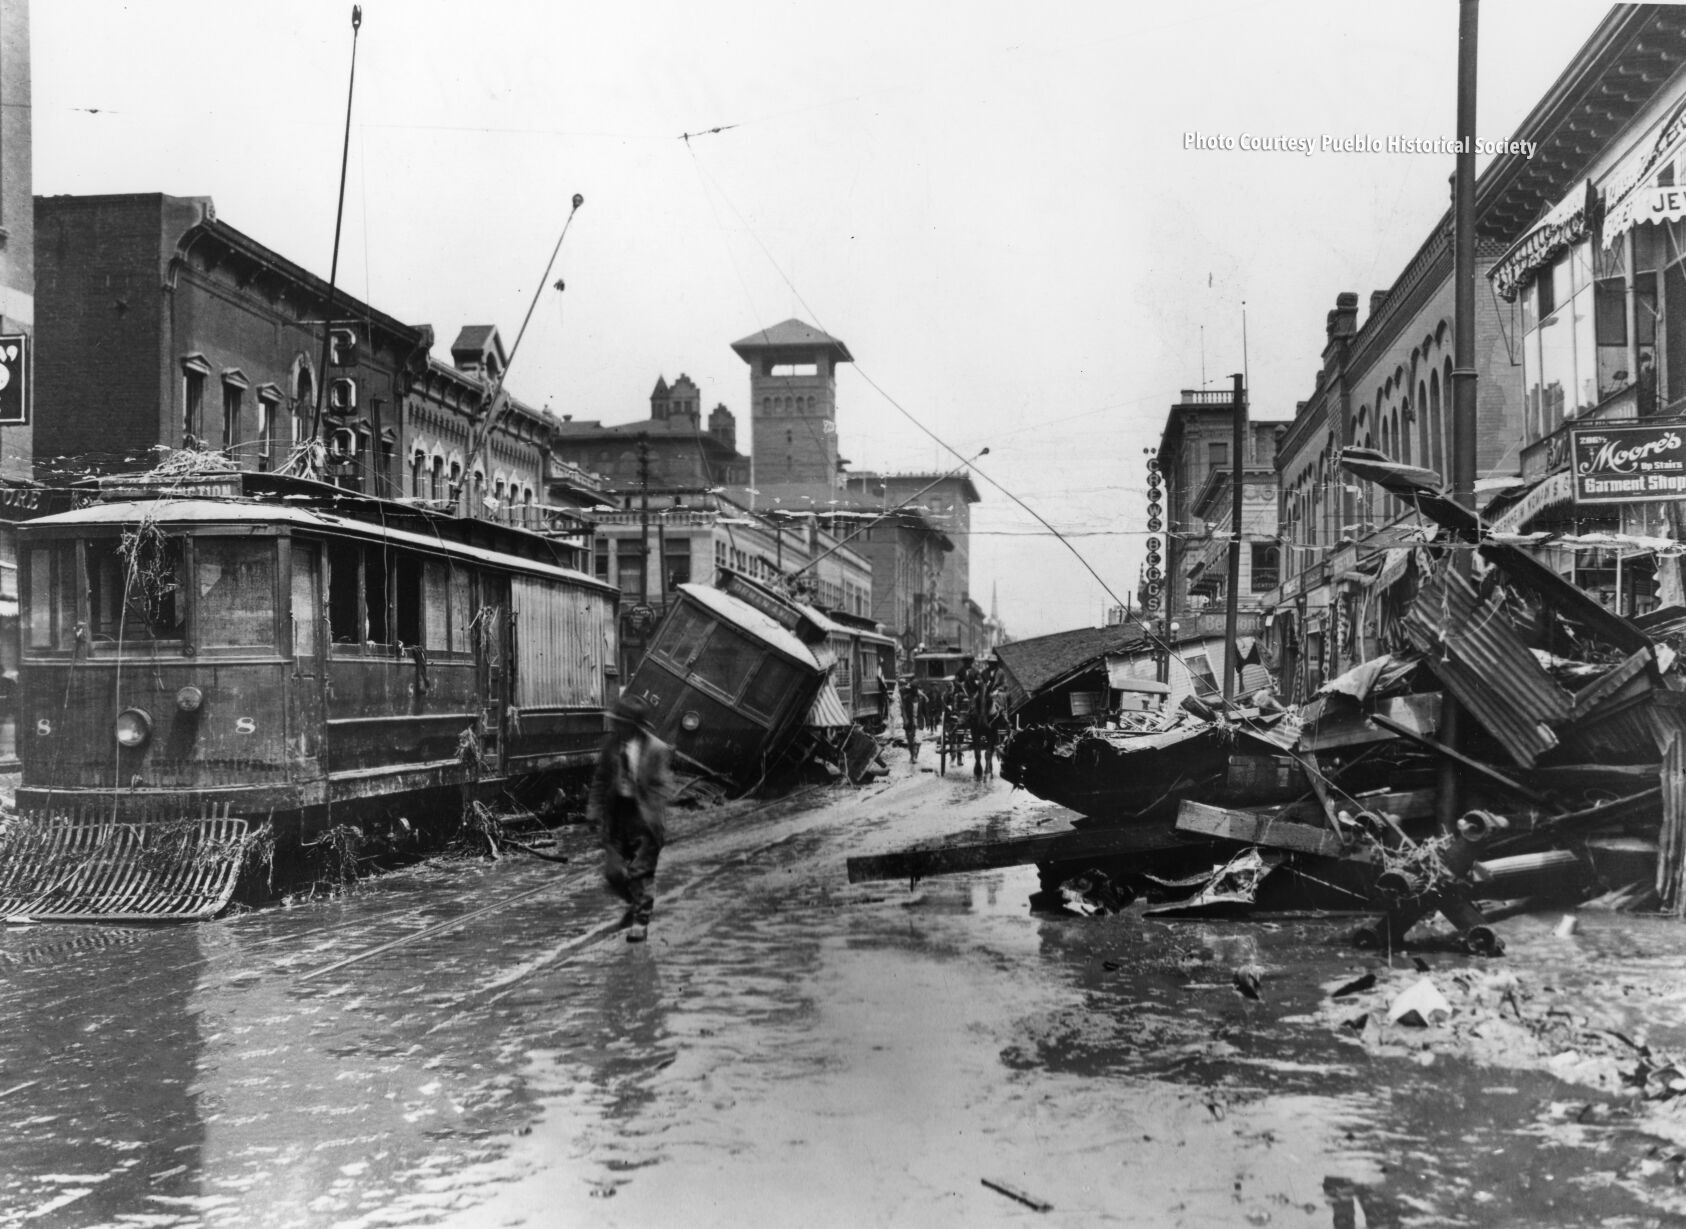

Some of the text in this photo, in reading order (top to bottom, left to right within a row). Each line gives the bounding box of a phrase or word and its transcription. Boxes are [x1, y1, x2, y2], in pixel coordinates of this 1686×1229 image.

[1579, 431, 1682, 474] Moore's
[1640, 459, 1683, 471] Up Stairs
[1584, 476, 1647, 493] Garment
[1648, 474, 1686, 492] Shop
[1147, 458, 1162, 611] CREWS BEGGS
[1205, 614, 1262, 630] Belont
[36, 718, 51, 736] 8
[235, 717, 256, 735] 8
